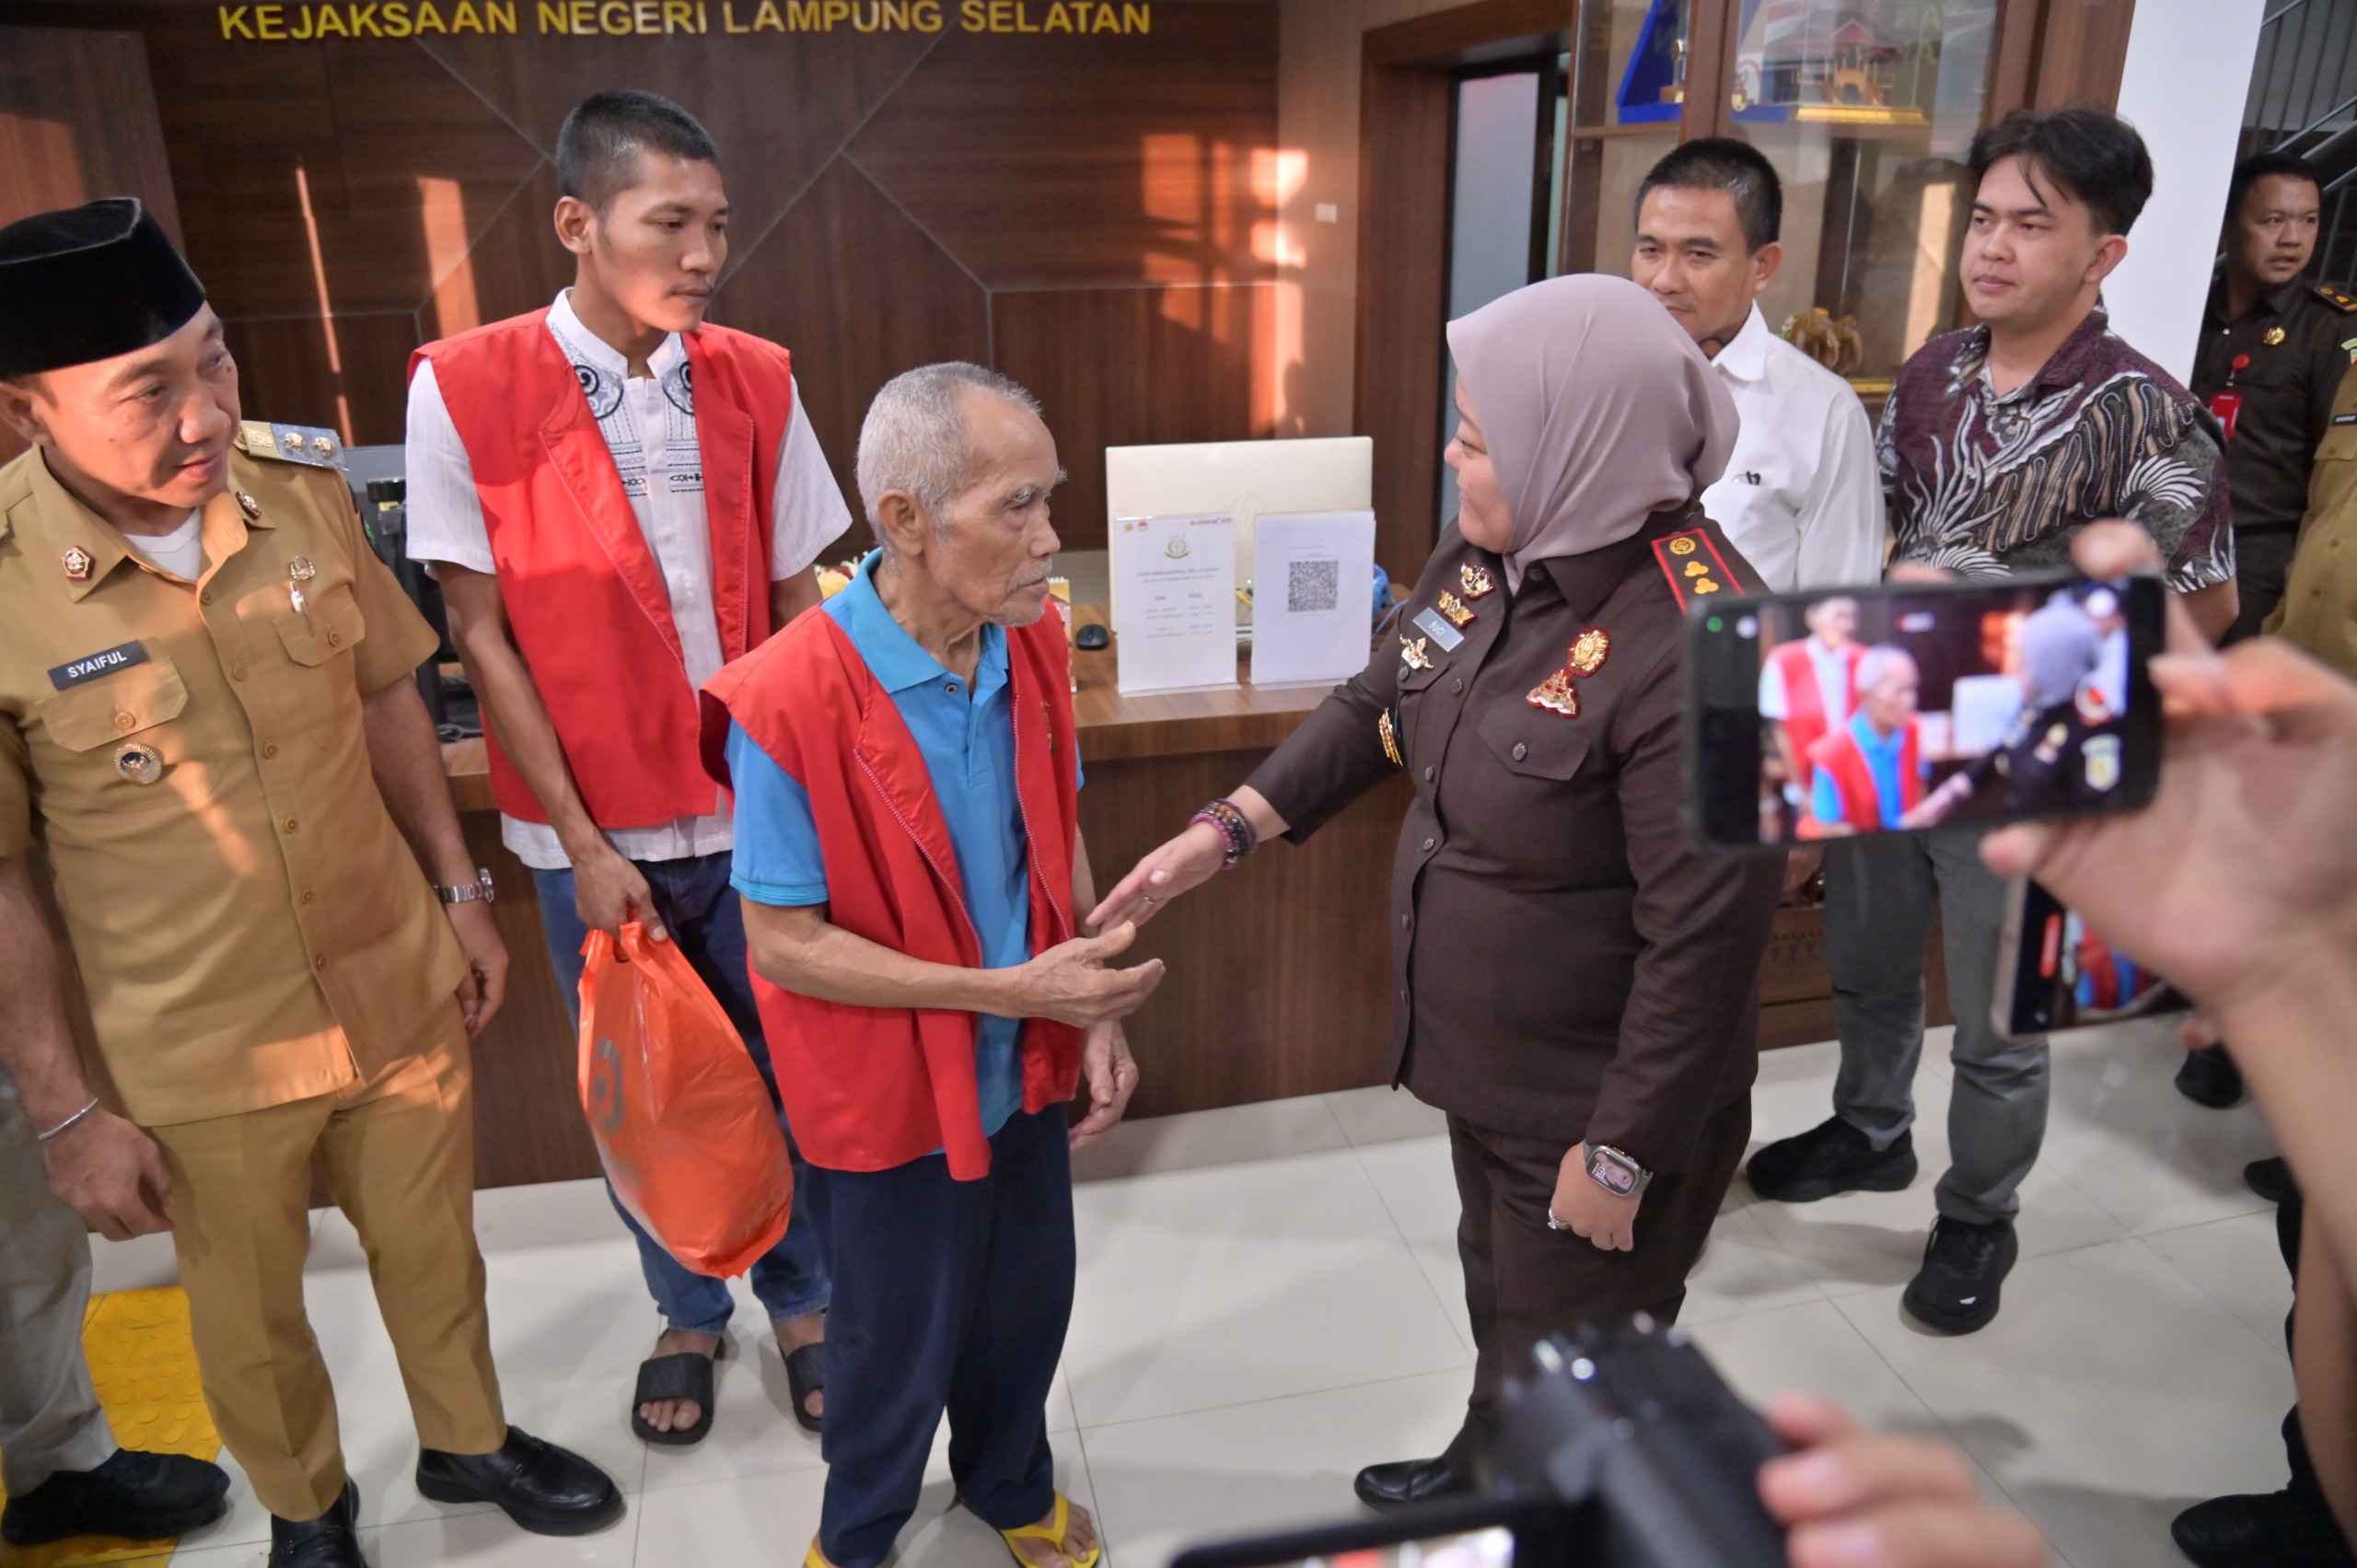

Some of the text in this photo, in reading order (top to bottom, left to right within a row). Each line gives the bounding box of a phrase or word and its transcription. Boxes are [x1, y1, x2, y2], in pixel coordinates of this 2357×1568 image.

[218, 0, 1151, 40] KEJAKSAAN NEGERI LAMPUNG SELATAN
[67, 650, 127, 678] SYAIFUL
